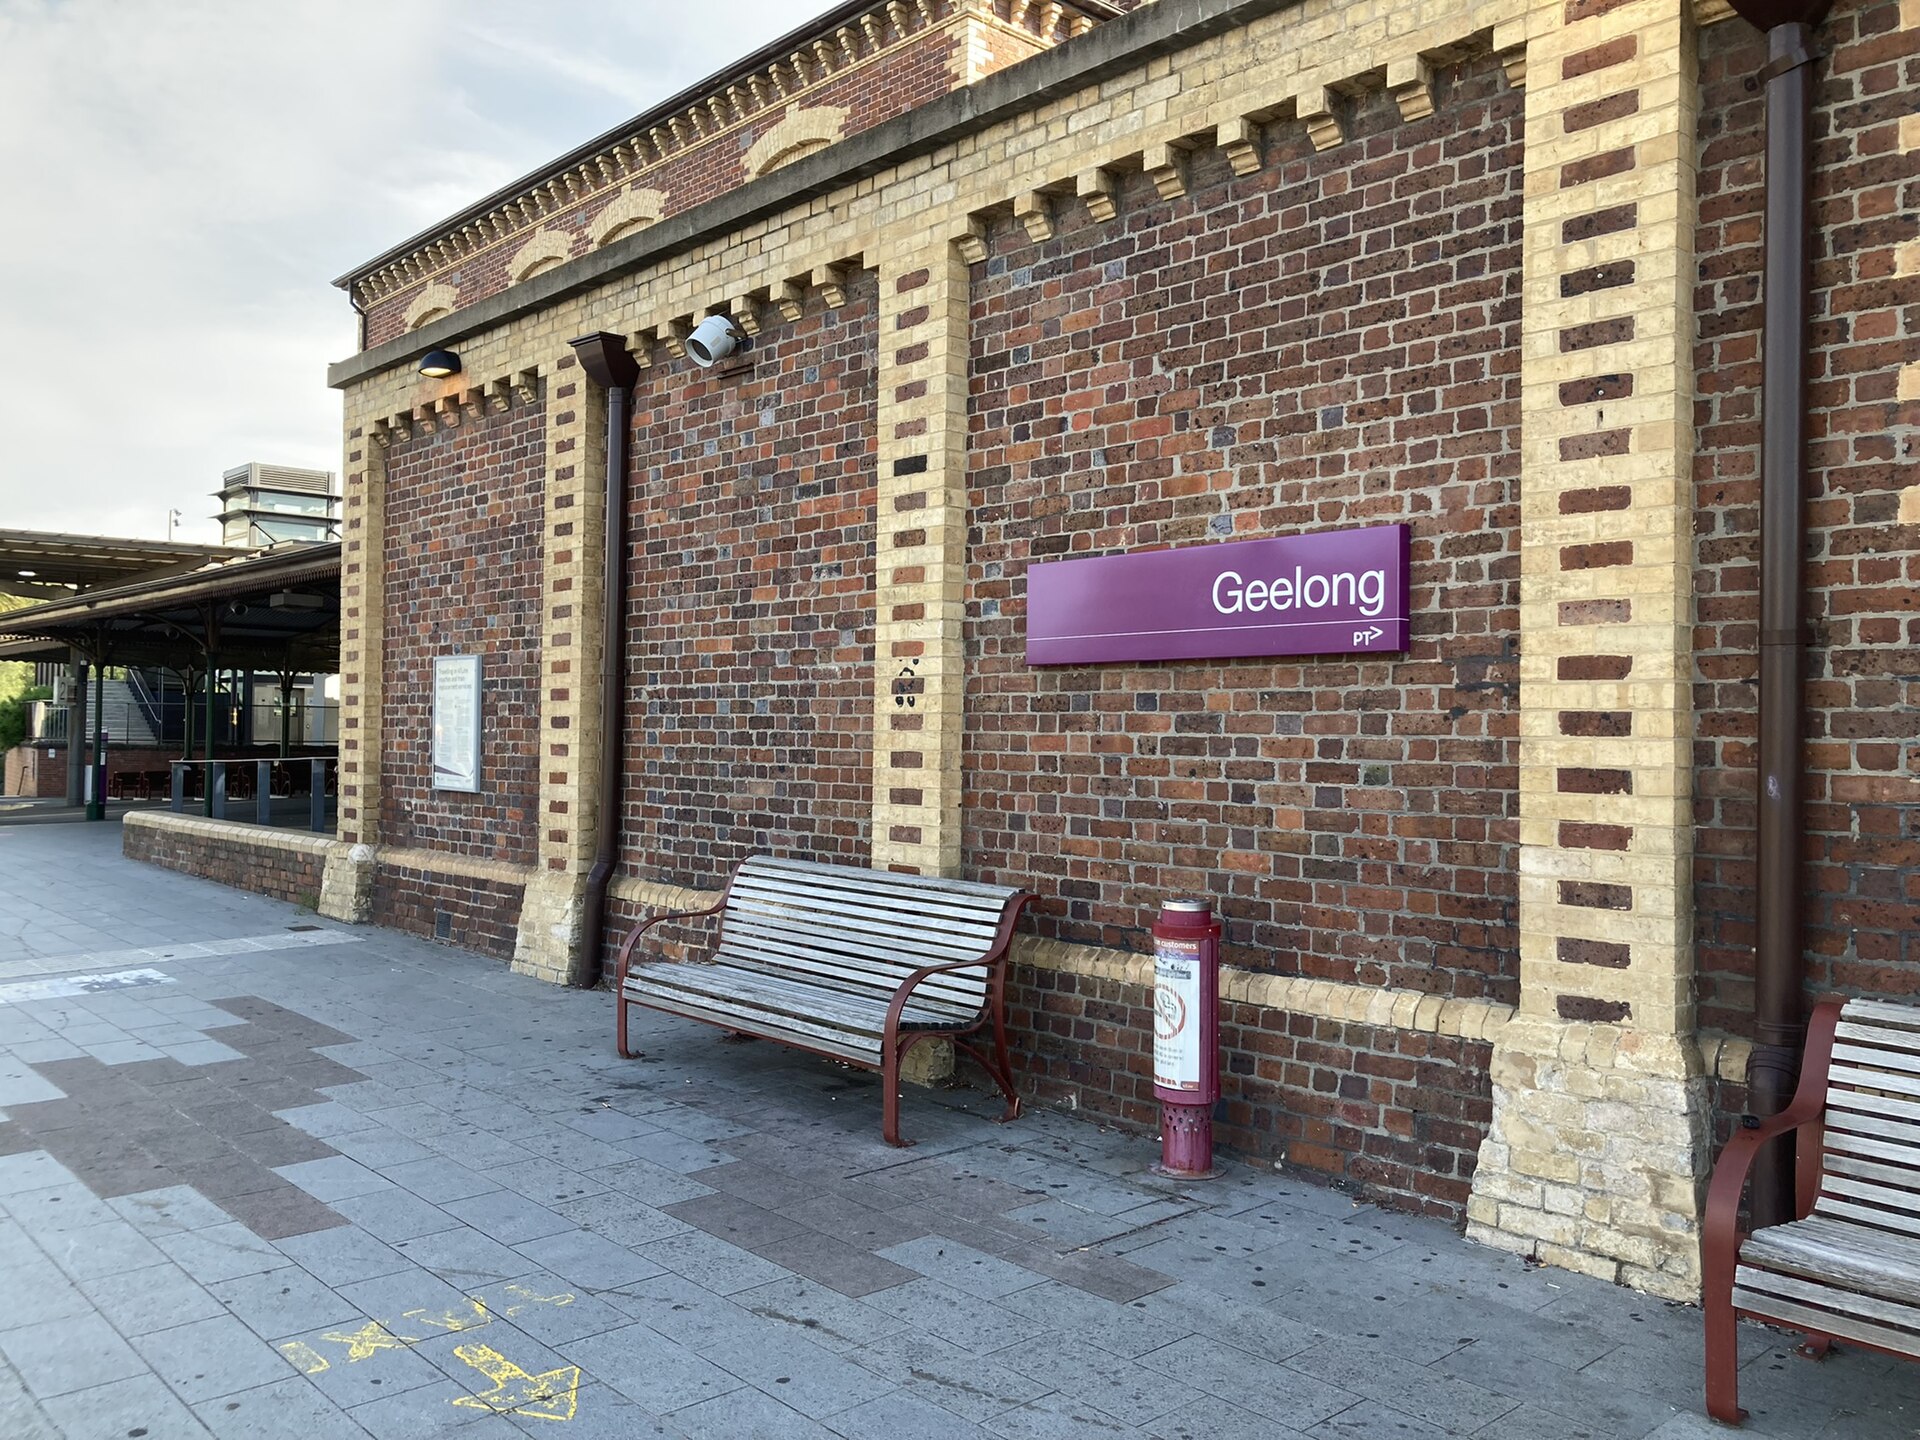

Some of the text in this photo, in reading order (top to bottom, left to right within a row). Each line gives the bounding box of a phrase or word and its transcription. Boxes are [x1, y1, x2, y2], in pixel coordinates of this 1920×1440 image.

[1211, 566, 1385, 616] Geelong
[59, 681, 66, 700] 2
[1161, 940, 1197, 950] customers
